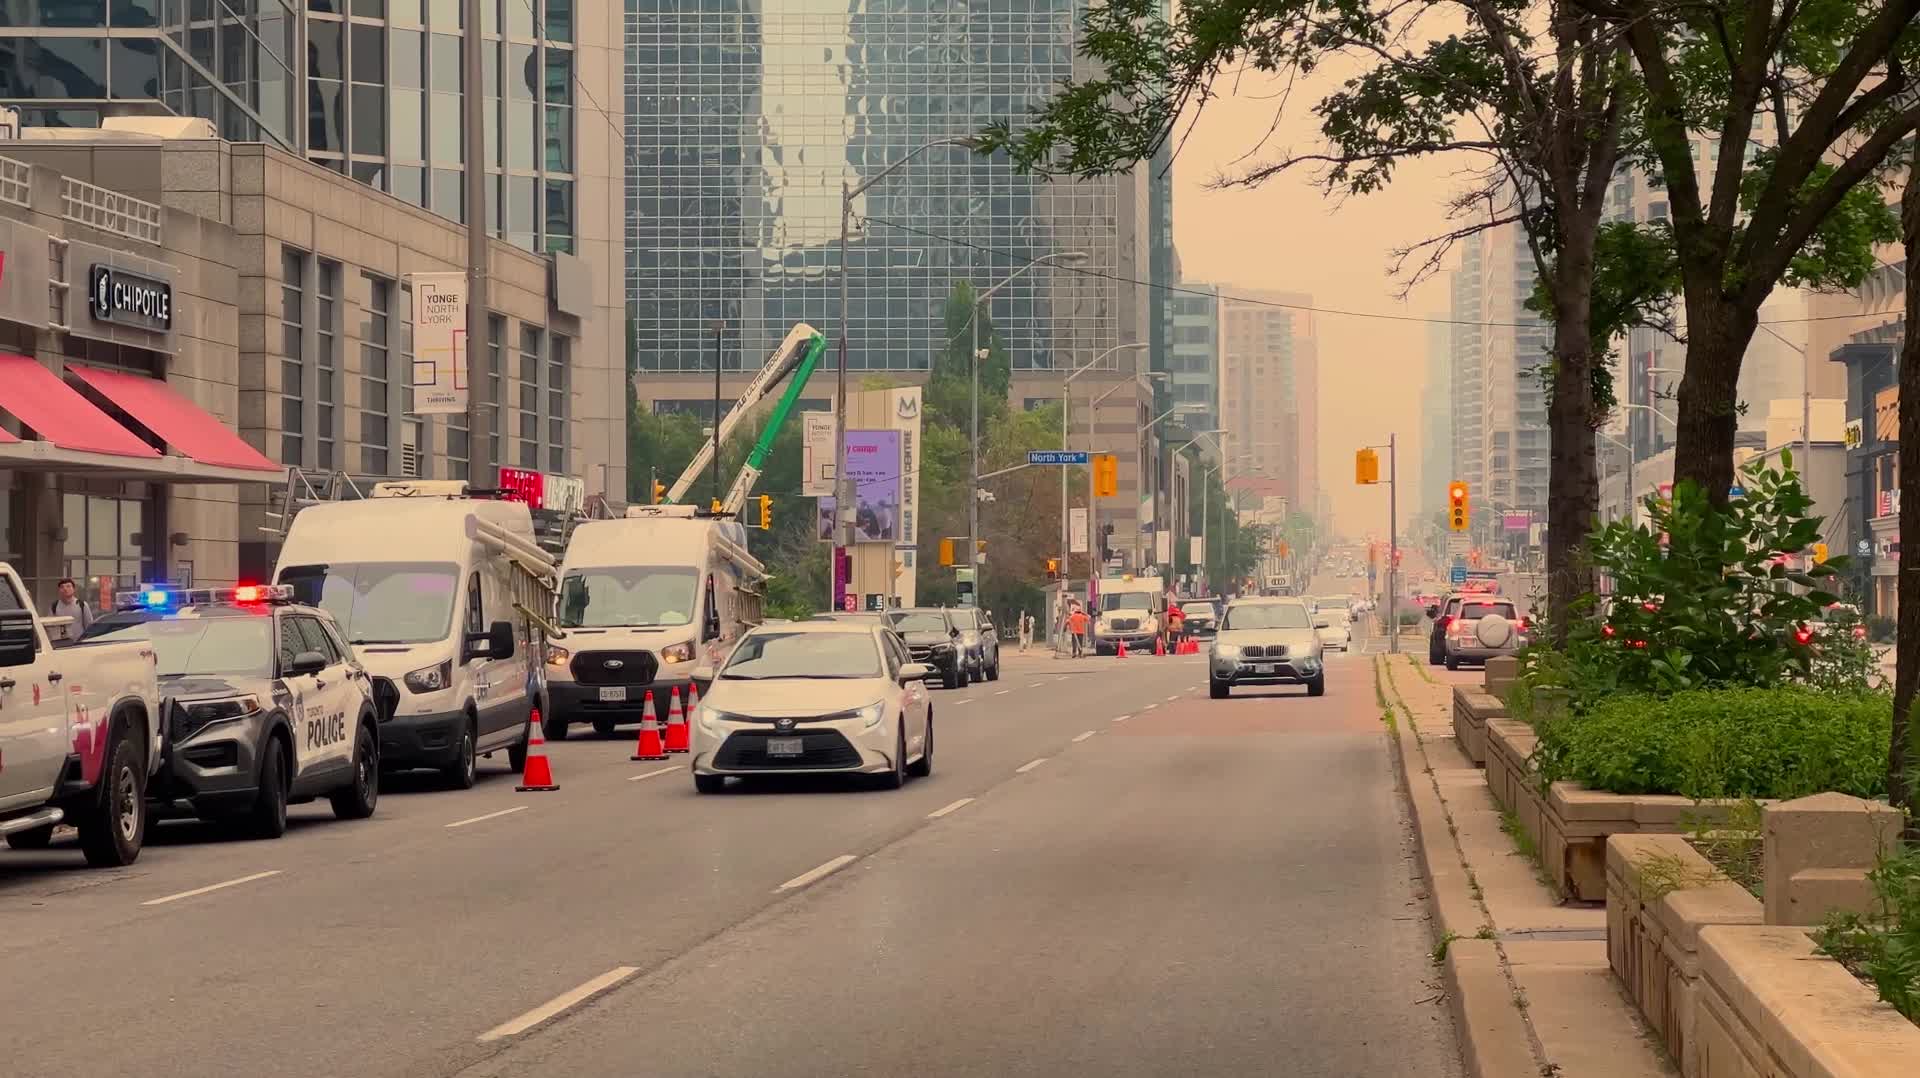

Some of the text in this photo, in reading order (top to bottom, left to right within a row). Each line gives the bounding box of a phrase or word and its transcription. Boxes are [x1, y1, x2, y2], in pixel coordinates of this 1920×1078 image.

[114, 282, 169, 320] CHIPOTLE
[427, 294, 459, 303] YONGE
[427, 304, 459, 313] NORTH
[428, 314, 452, 324] YORK
[1031, 453, 1056, 462] North
[1058, 453, 1077, 462] York
[307, 711, 346, 751] POLICE
